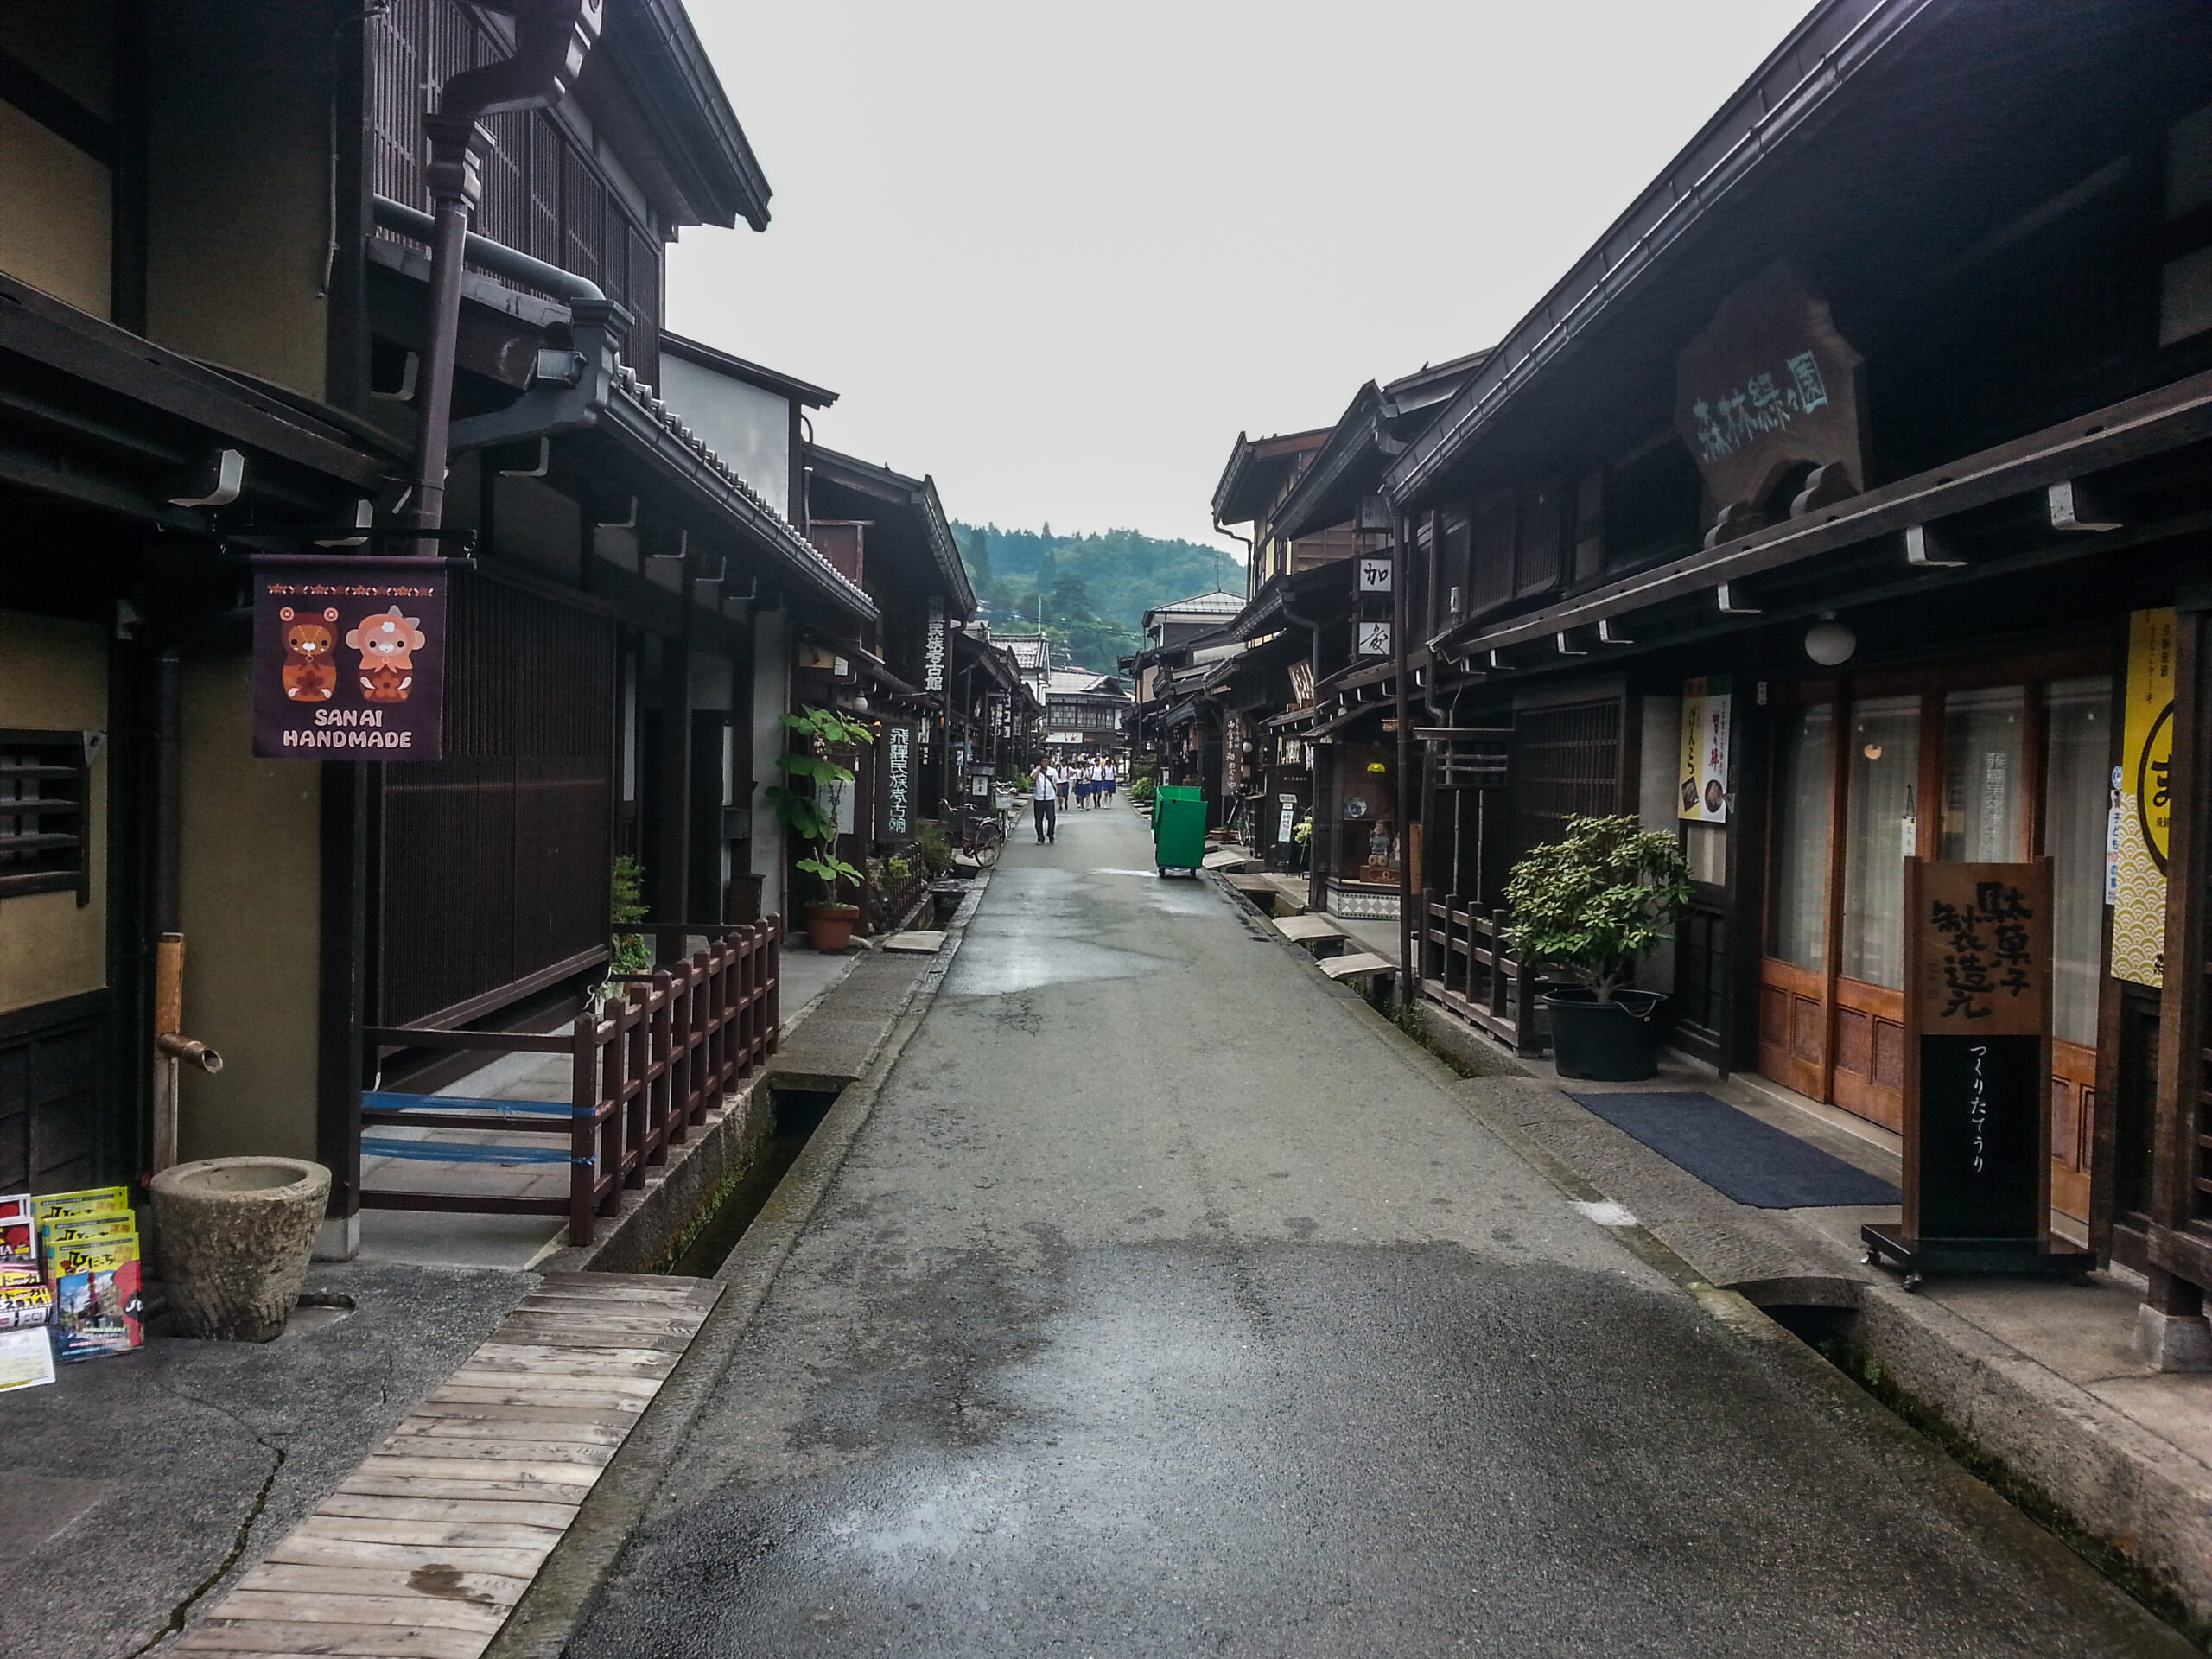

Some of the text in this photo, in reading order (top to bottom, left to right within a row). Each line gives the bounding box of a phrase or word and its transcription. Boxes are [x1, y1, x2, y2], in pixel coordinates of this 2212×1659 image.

[283, 730, 413, 748] HANDMADE
[314, 709, 384, 728] SANAI
[1930, 899, 1995, 1020] 製造元
[1974, 881, 2034, 997] 駄菓子
[1969, 1045, 1987, 1173] つくりたてうり
